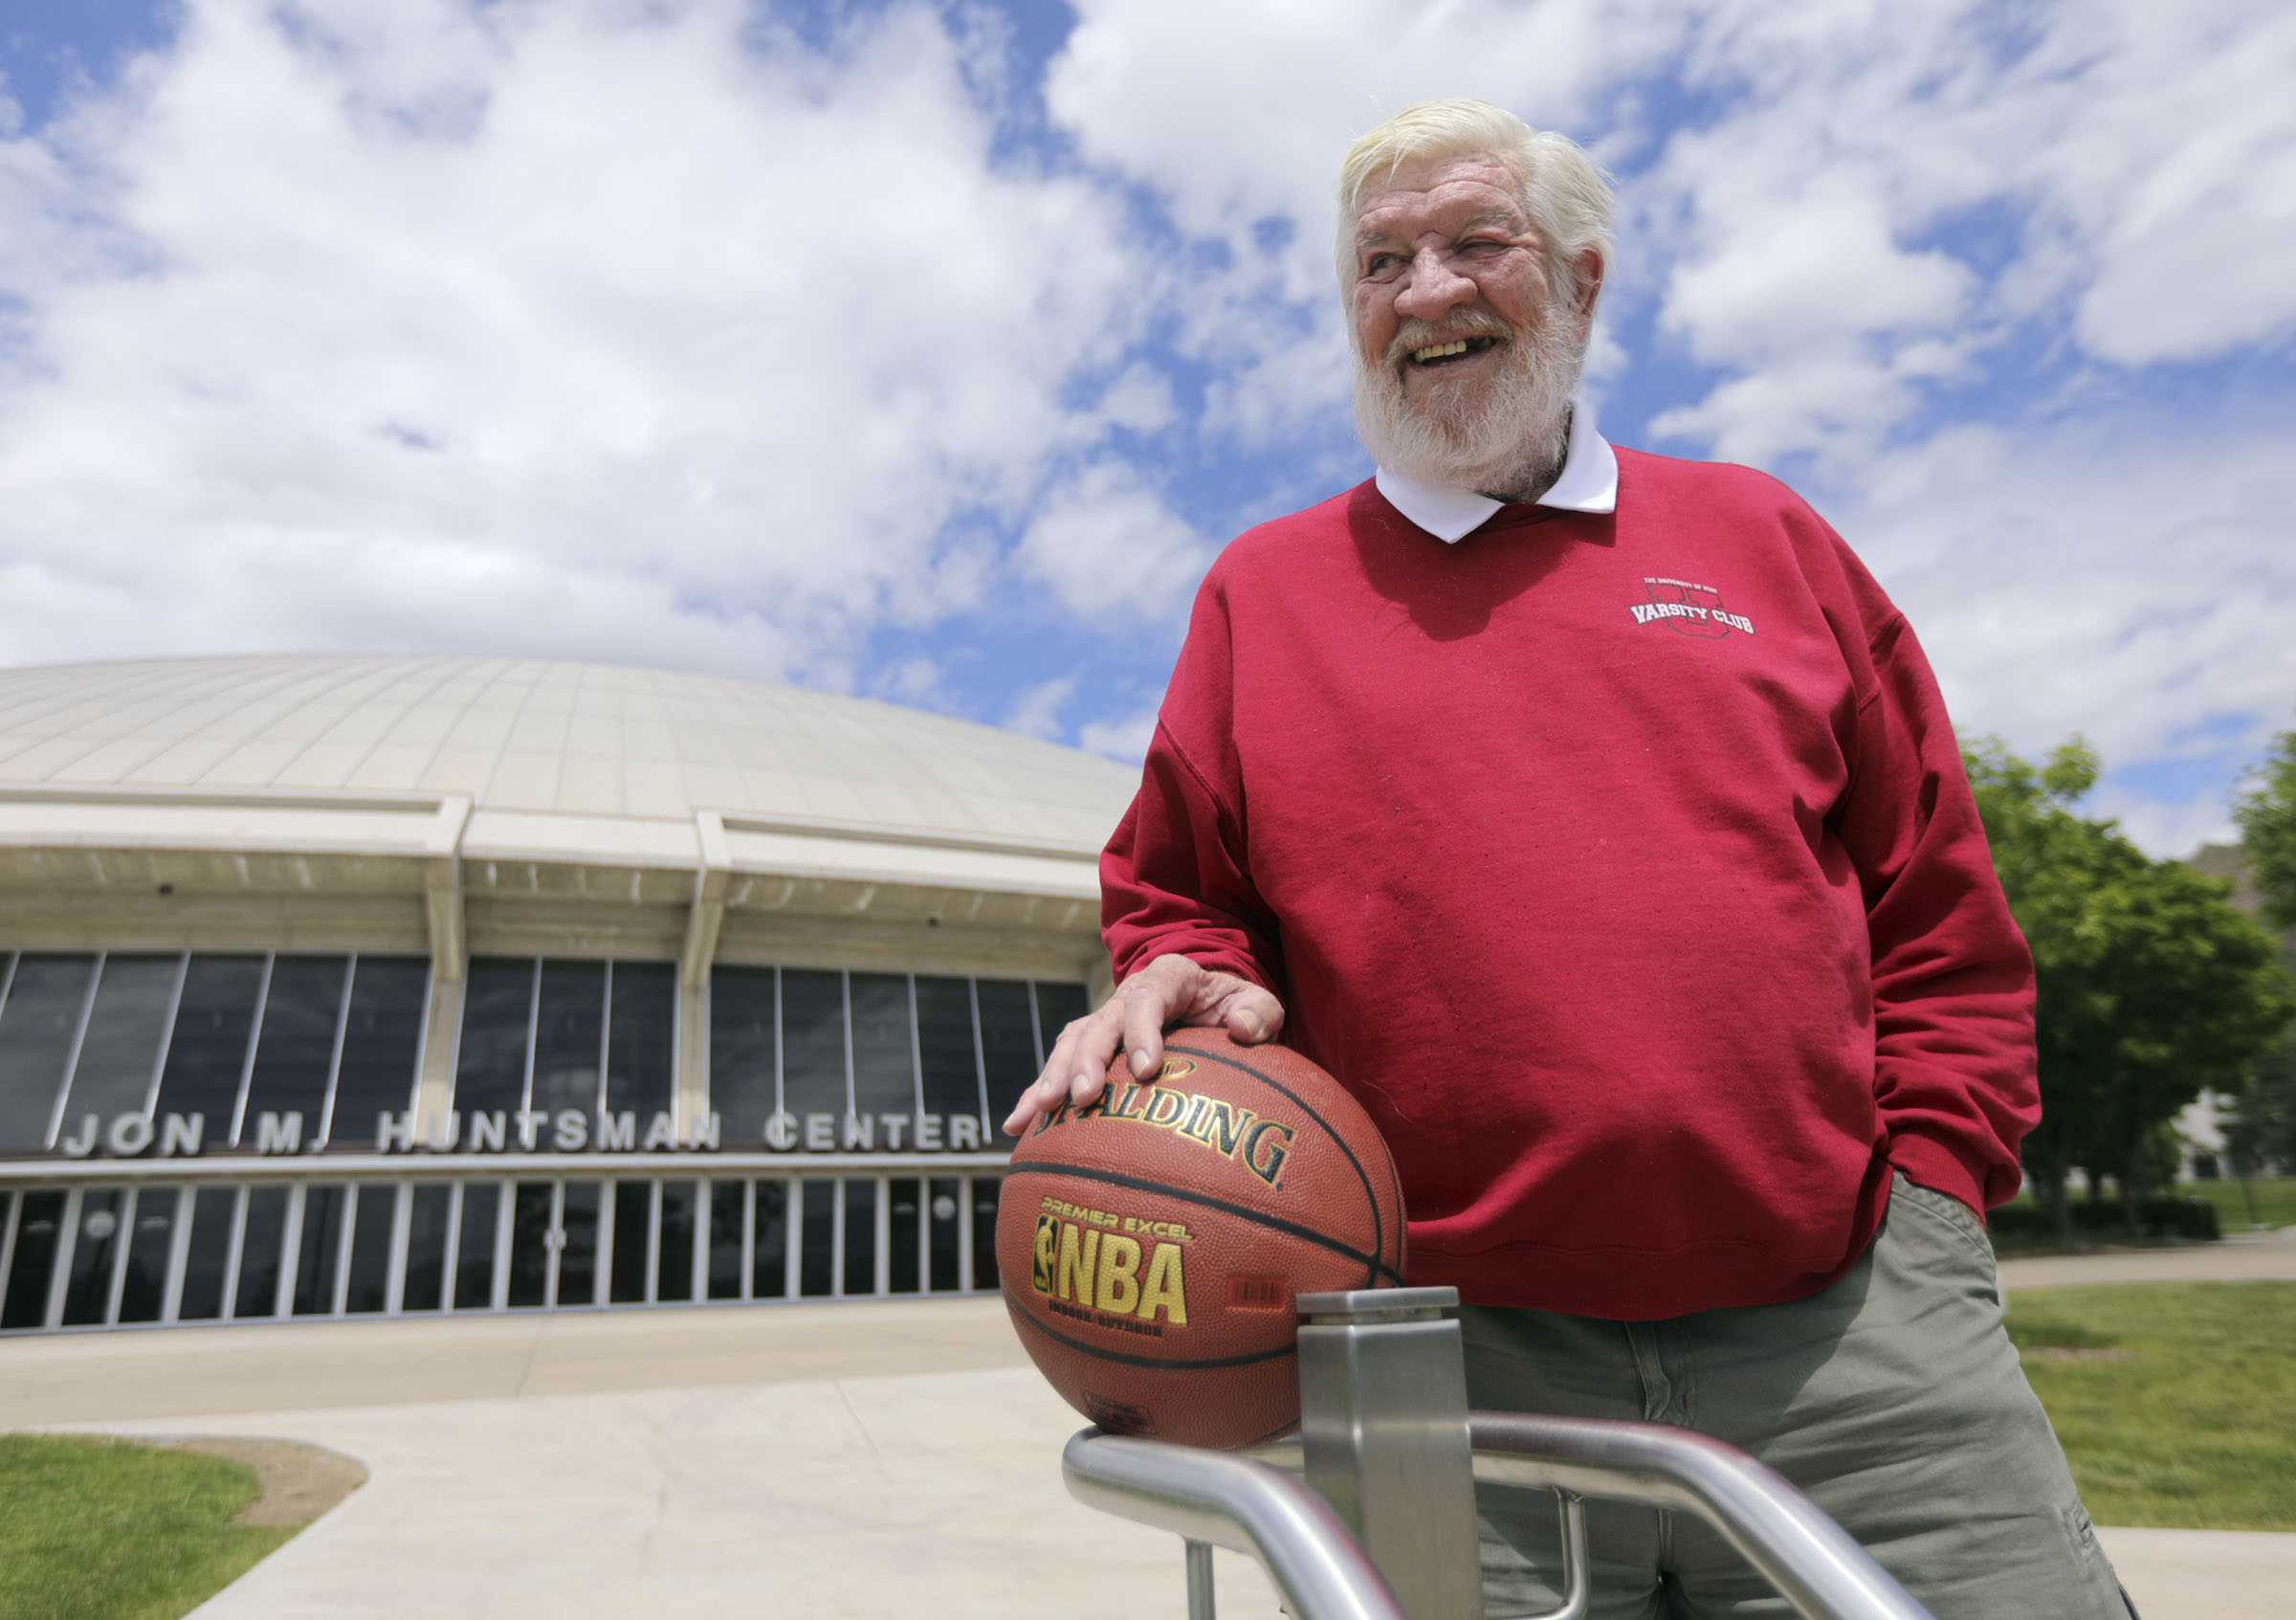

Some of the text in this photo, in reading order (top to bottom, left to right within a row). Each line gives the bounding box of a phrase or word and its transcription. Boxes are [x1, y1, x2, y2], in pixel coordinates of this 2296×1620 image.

[1630, 603, 1755, 634] VARSITY CLUB
[62, 1109, 982, 1158] JON M. HUNTSMAN CENTER
[1041, 1196, 1195, 1240] PREMIER EXCEL
[1058, 1222, 1188, 1325] NBA
